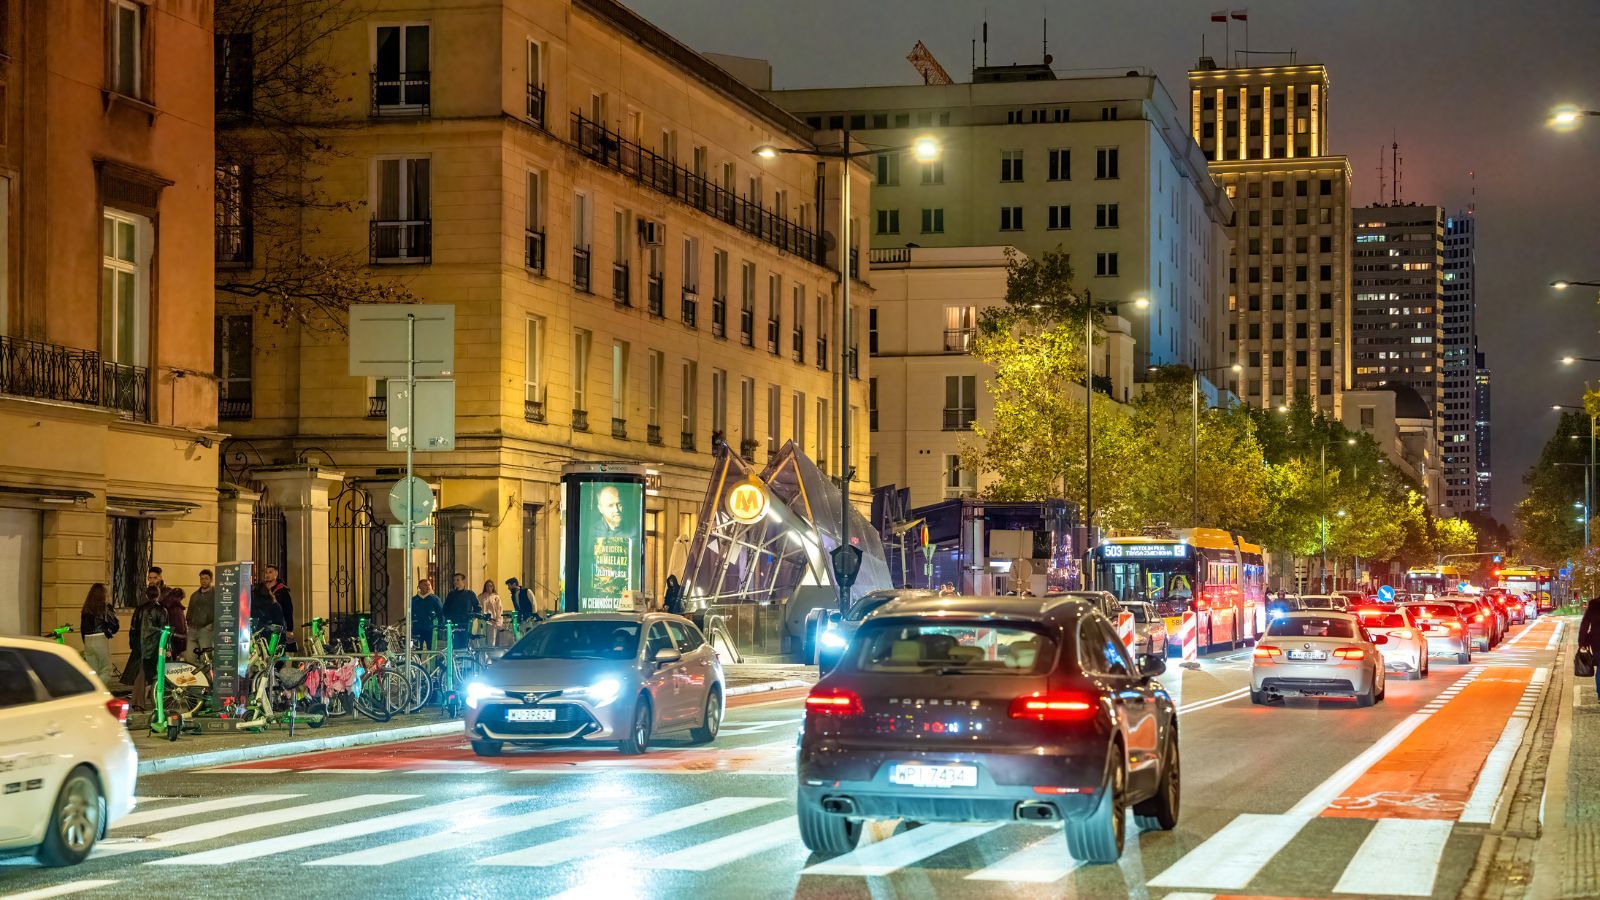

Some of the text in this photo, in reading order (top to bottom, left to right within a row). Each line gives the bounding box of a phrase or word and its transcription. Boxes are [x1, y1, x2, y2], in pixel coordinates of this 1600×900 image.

[1105, 545, 1122, 557] 503
[582, 597, 588, 609] W
[166, 665, 194, 675] Knoppers
[889, 698, 980, 707] PORSCHE
[931, 768, 965, 782] 7434
